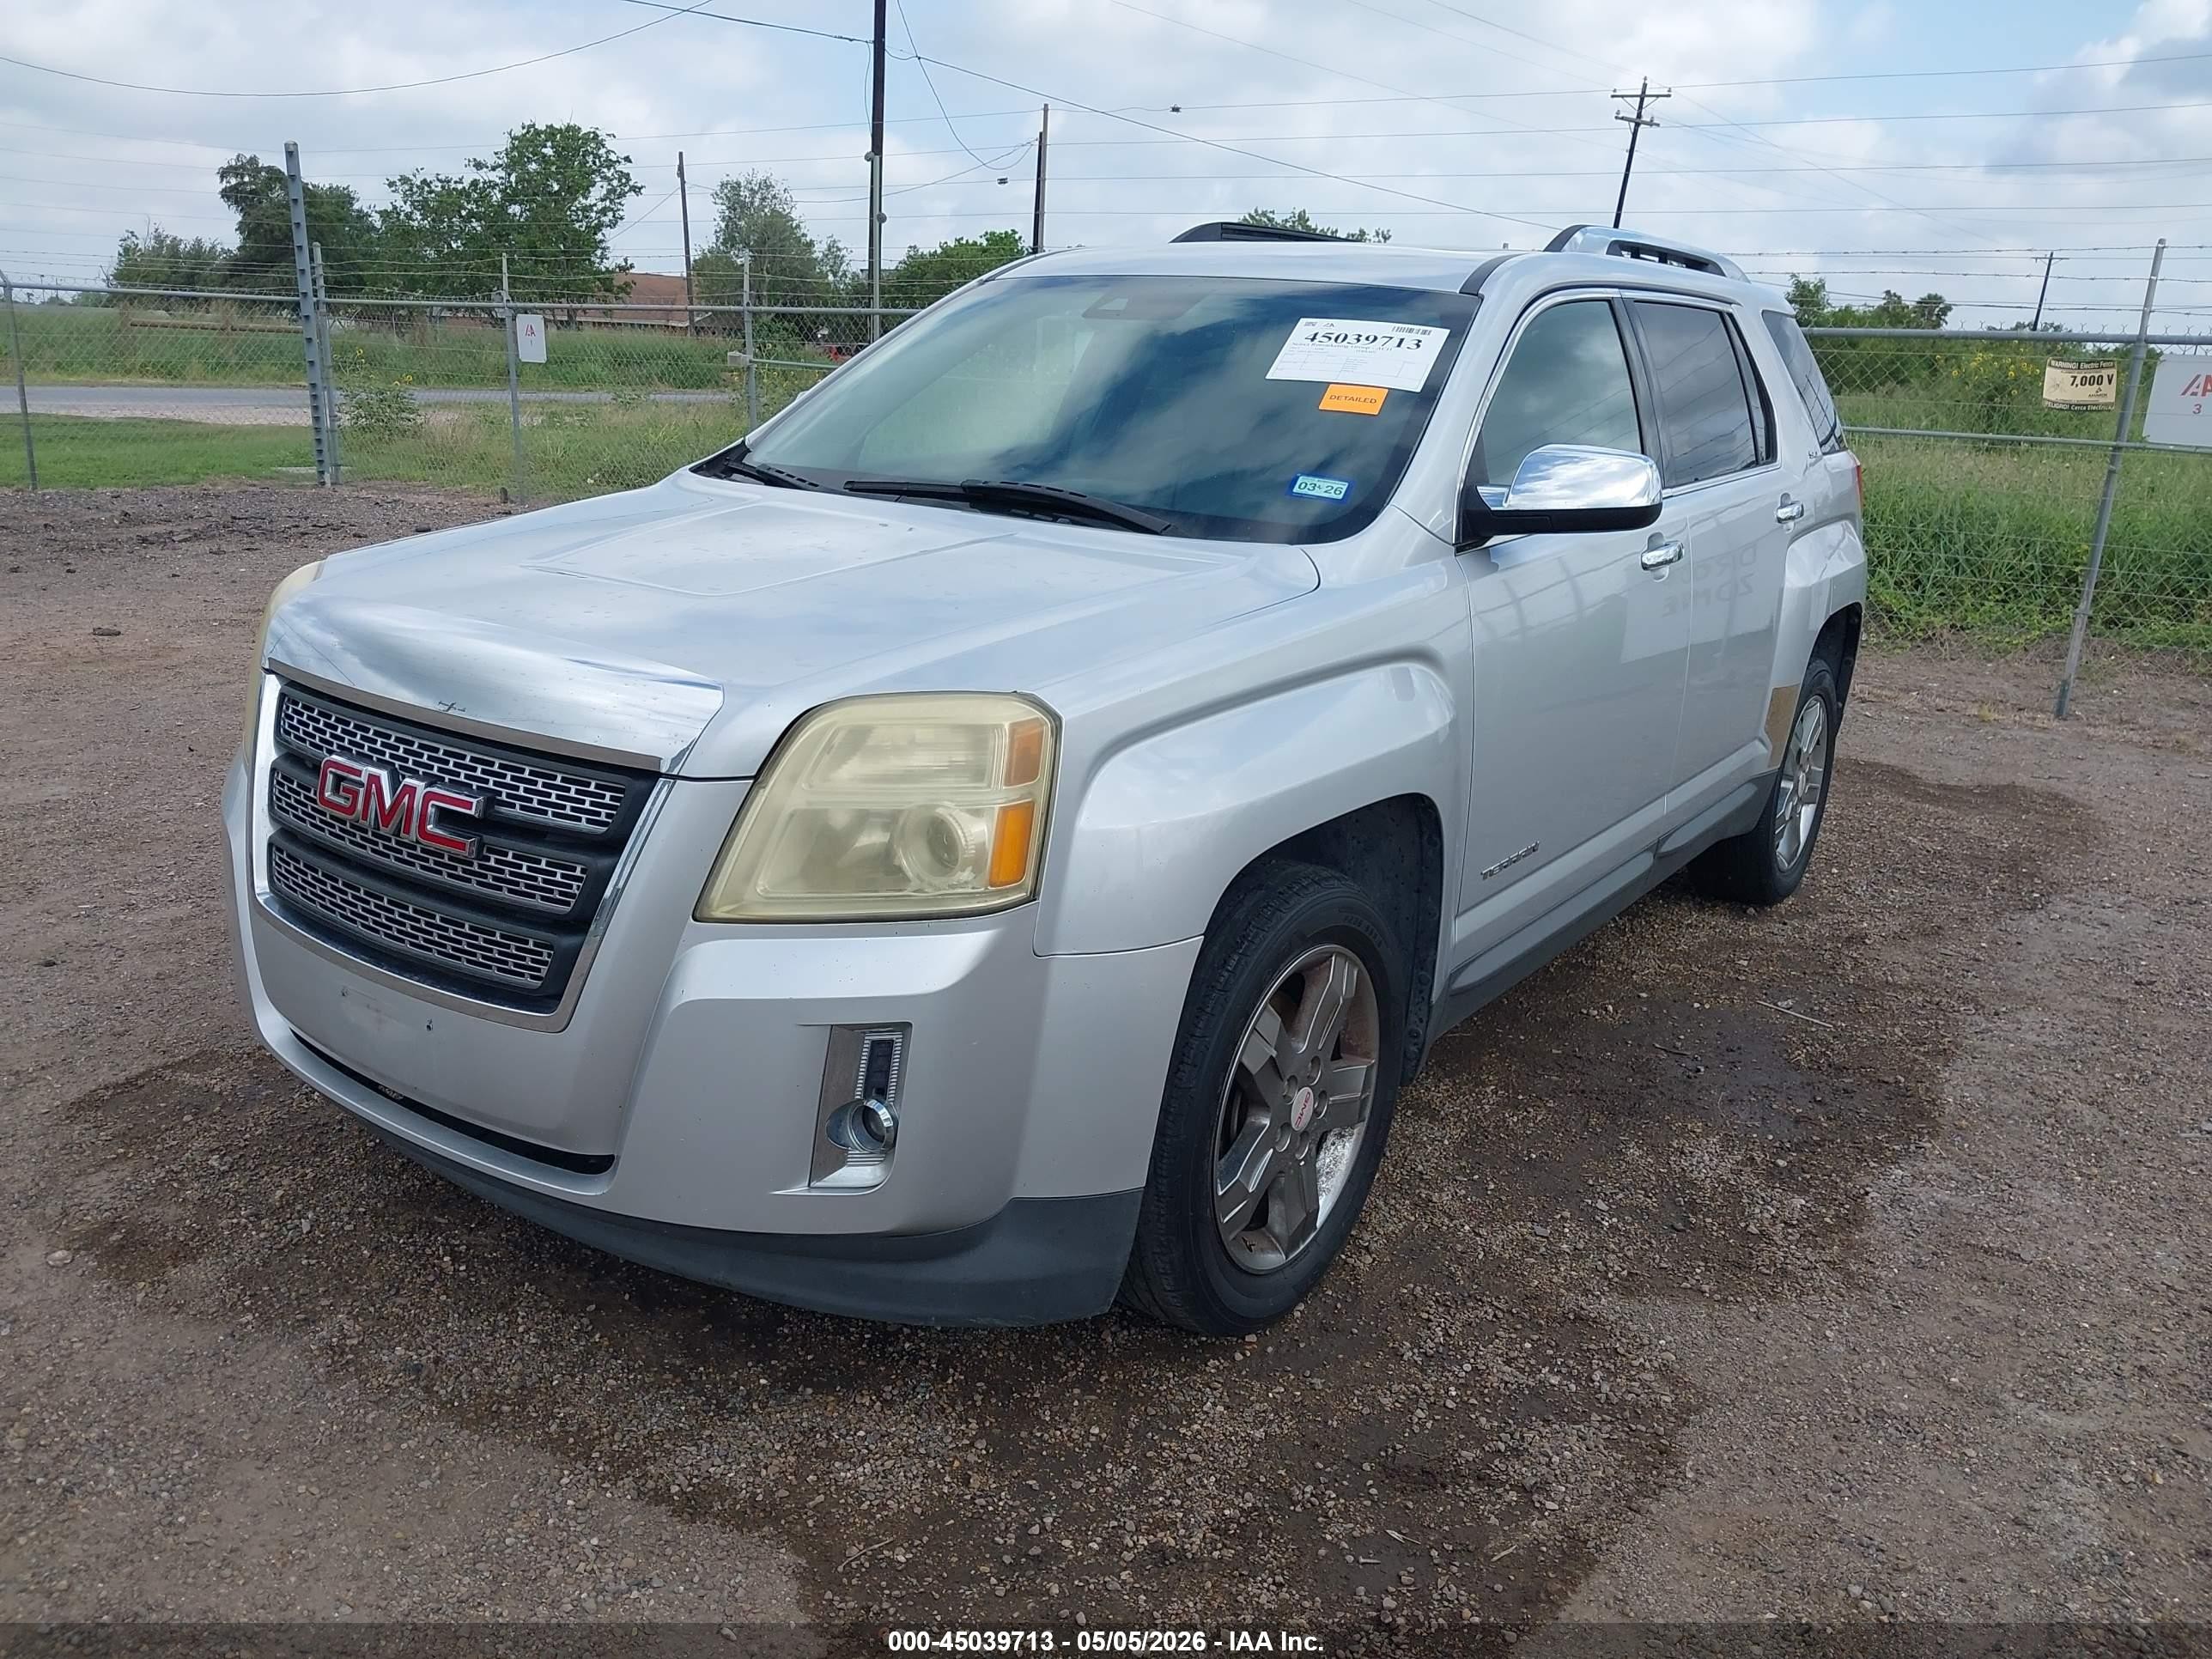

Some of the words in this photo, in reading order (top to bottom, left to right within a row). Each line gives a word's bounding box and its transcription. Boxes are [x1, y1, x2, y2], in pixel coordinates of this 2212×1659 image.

[1304, 331, 1423, 350] 45039713
[2051, 360, 2079, 369] WARNING!
[2070, 374, 2104, 387] 7,000
[2106, 374, 2114, 386] V
[1329, 394, 1377, 404] DETAILED
[2192, 404, 2203, 415] 3
[1297, 481, 1317, 492] 03
[1323, 485, 1344, 495] 26
[317, 754, 485, 859] GMC
[1295, 1091, 1311, 1127] GMC
